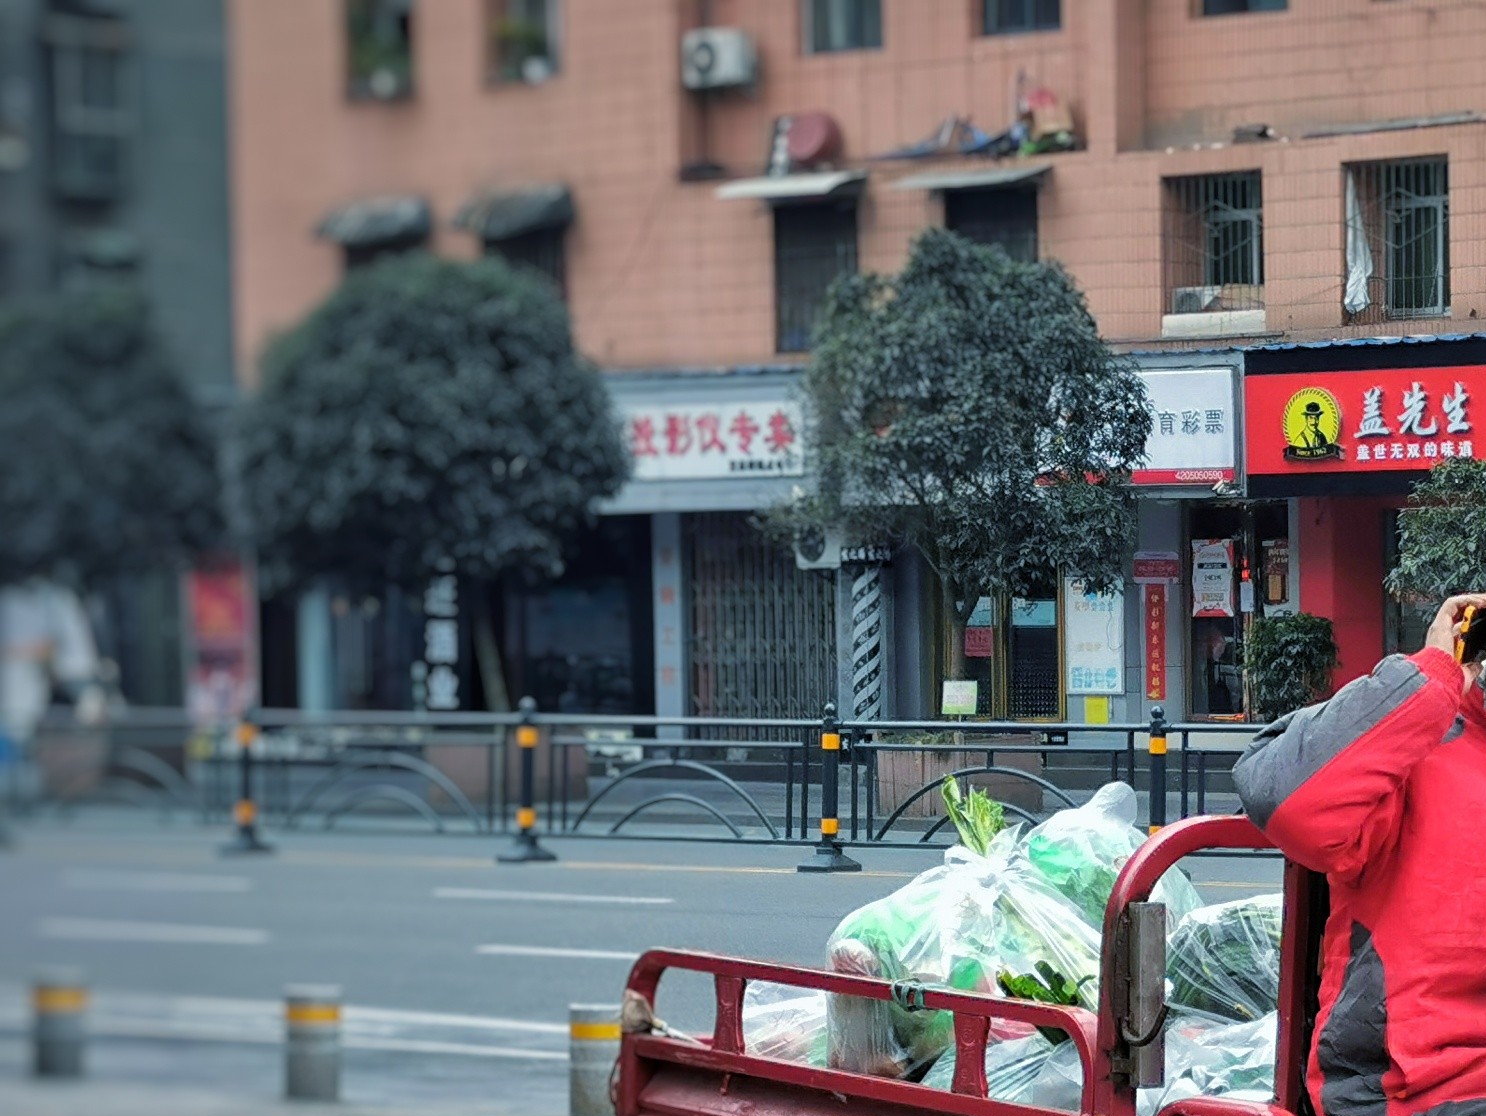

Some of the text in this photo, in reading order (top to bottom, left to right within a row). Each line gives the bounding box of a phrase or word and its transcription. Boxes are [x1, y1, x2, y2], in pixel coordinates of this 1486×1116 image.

[1150, 409, 1224, 435] 育彩票
[1354, 382, 1473, 438] 盖先生
[1356, 441, 1473, 461] 盖世无双的味道
